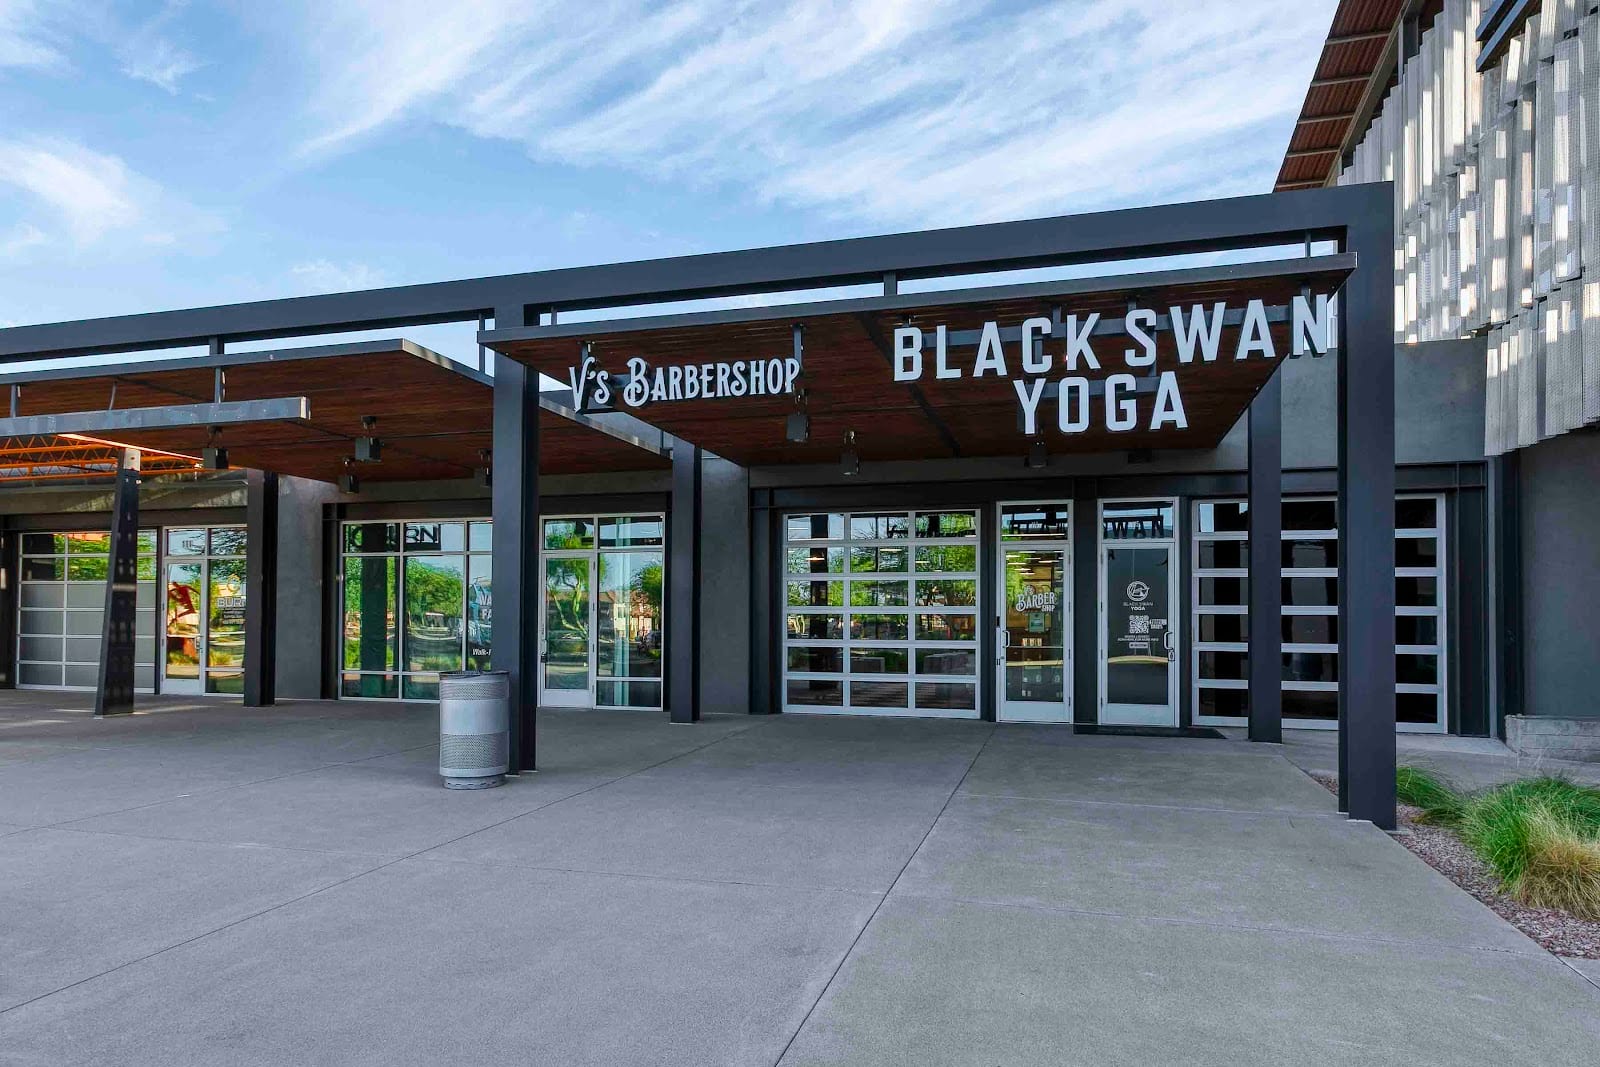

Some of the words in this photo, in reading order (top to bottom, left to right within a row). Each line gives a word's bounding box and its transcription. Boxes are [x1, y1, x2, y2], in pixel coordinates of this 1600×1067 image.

[893, 312, 1101, 382] BLACK
[1124, 294, 1328, 367] SWAN
[1012, 370, 1188, 435] YOGA
[1015, 592, 1055, 612] BARBER
